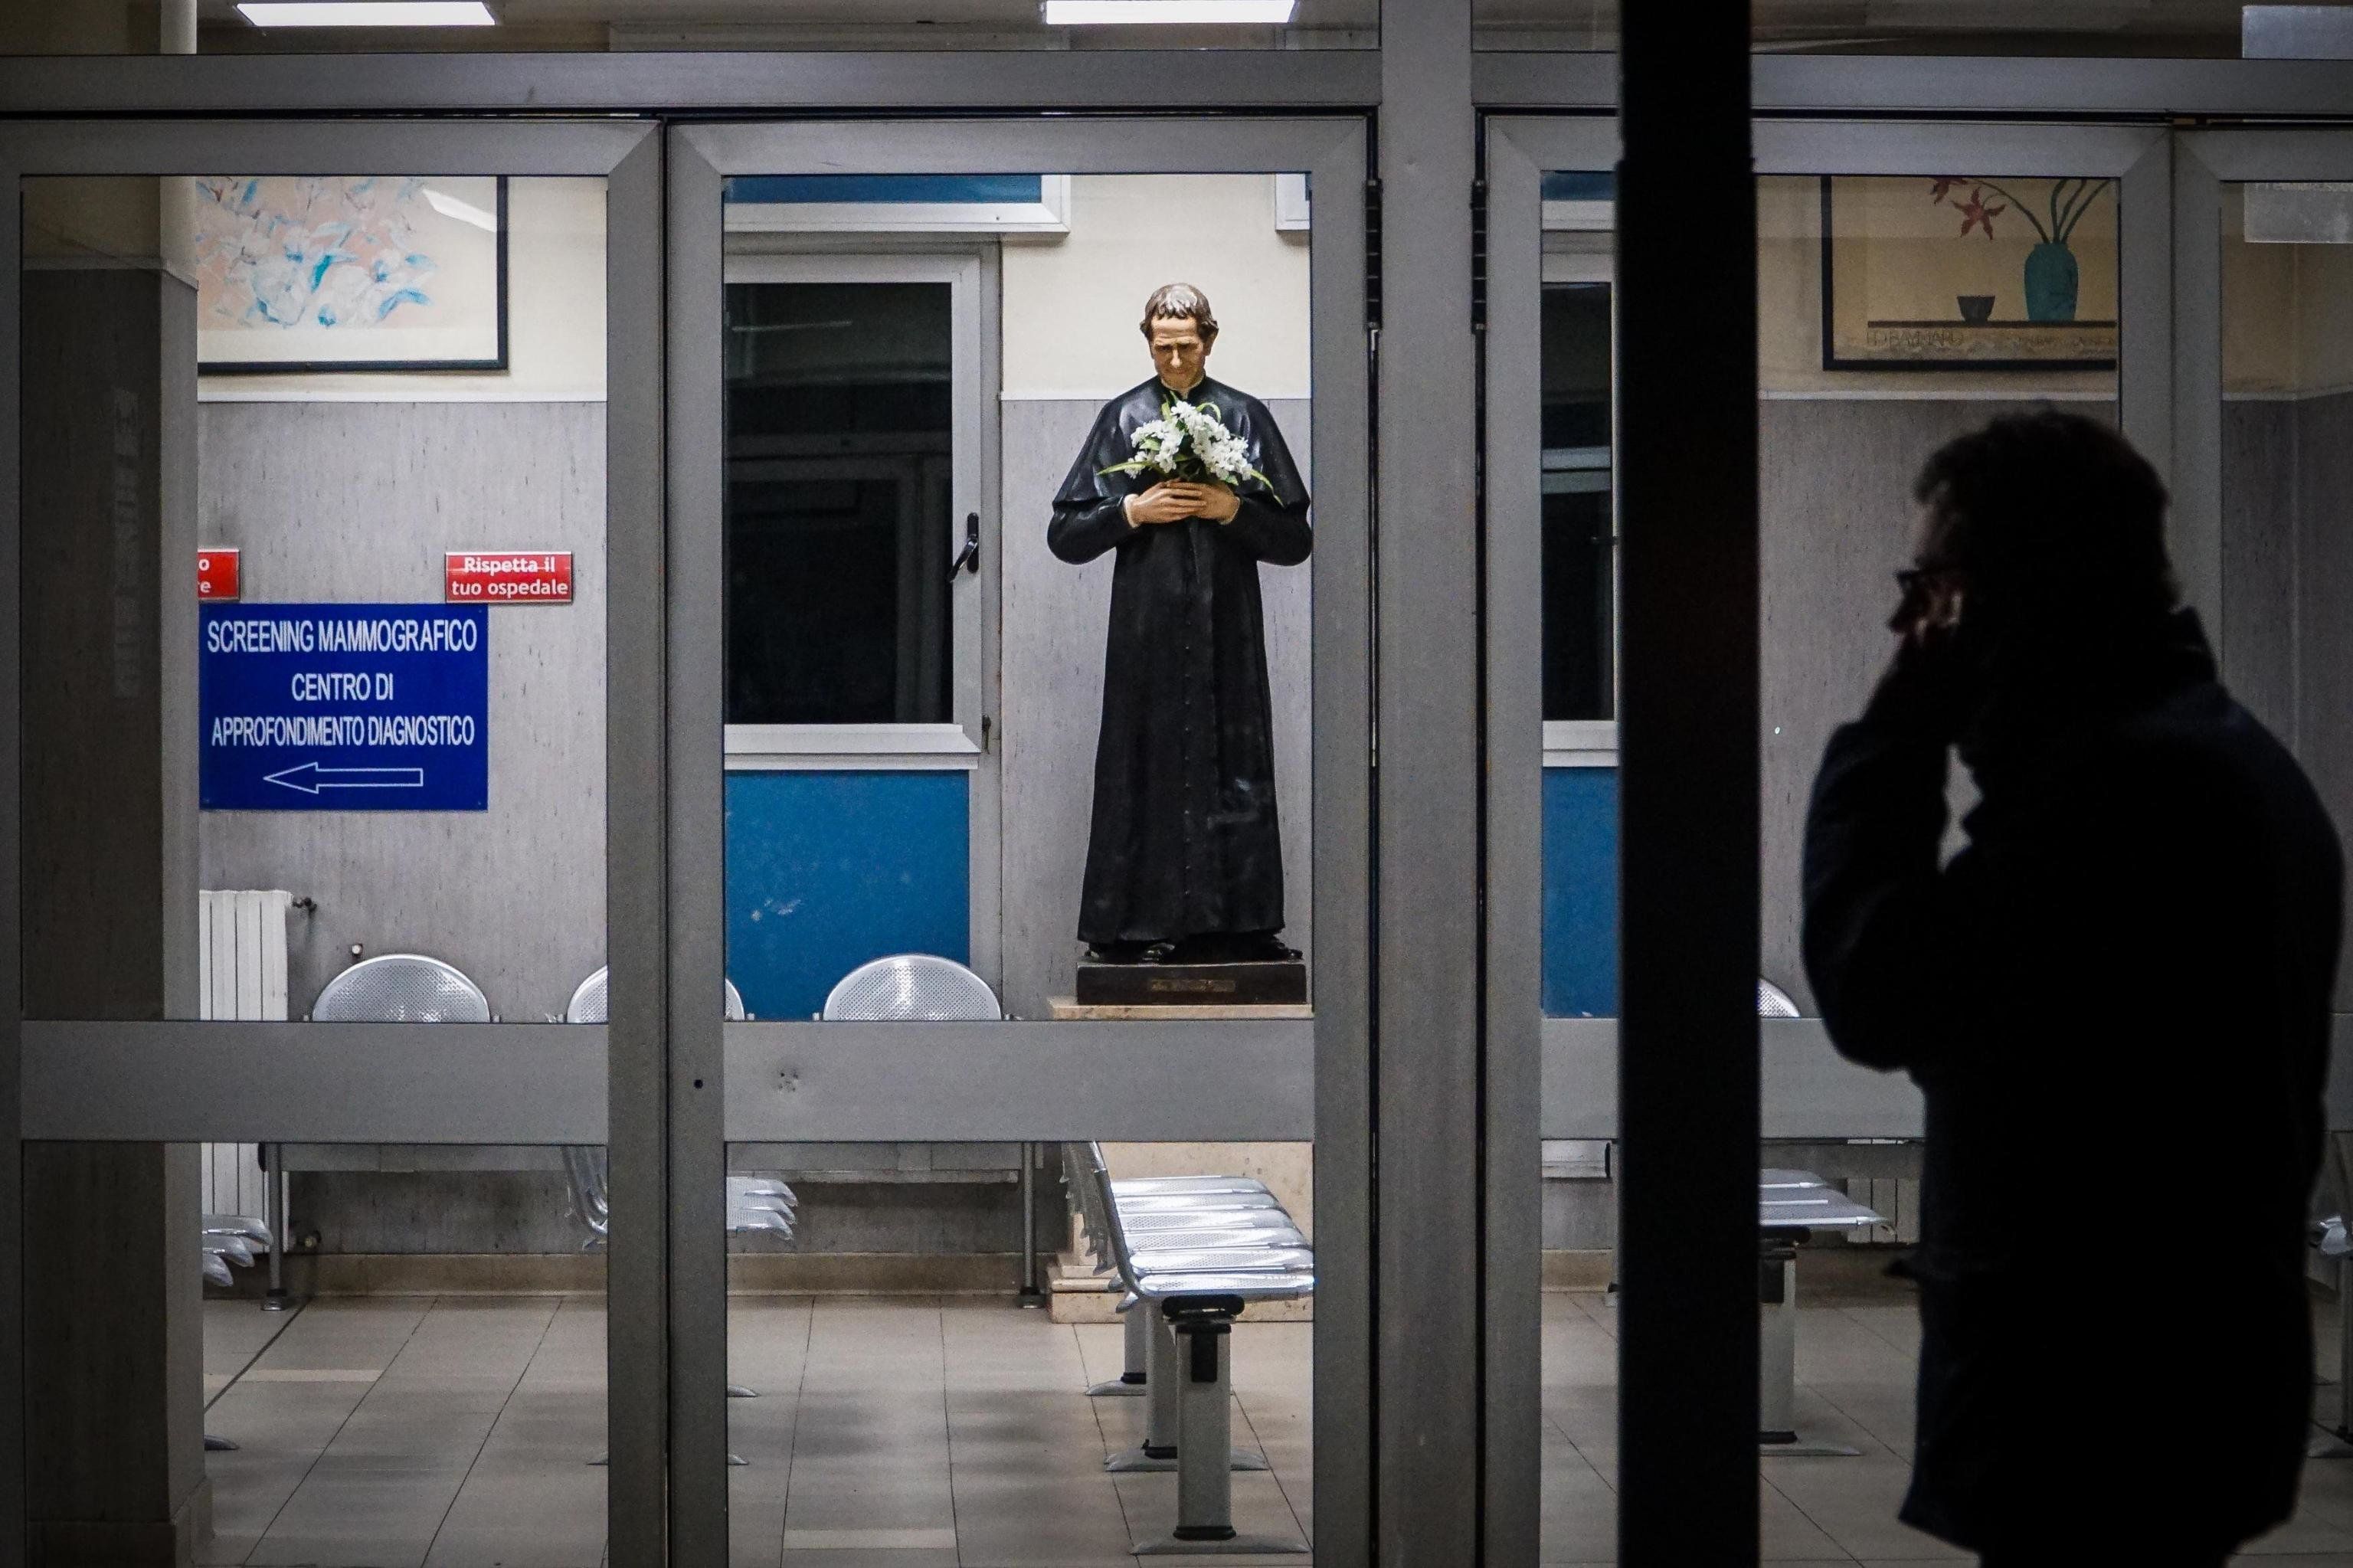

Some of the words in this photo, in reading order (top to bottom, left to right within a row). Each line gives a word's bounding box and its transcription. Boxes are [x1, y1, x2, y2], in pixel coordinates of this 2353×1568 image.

[464, 556, 538, 576] Rispetta
[544, 556, 555, 572] il
[197, 580, 211, 594] e
[452, 581, 482, 595] tuo
[487, 578, 568, 598] ospedale
[208, 620, 314, 653] SCREENING
[318, 619, 477, 652] MAMMOGRAFICO
[291, 673, 371, 702] CENTRO
[375, 673, 394, 701] DI
[211, 715, 365, 746] APPROFONDIMENTO
[368, 715, 475, 746] DIAGNOSTICO
